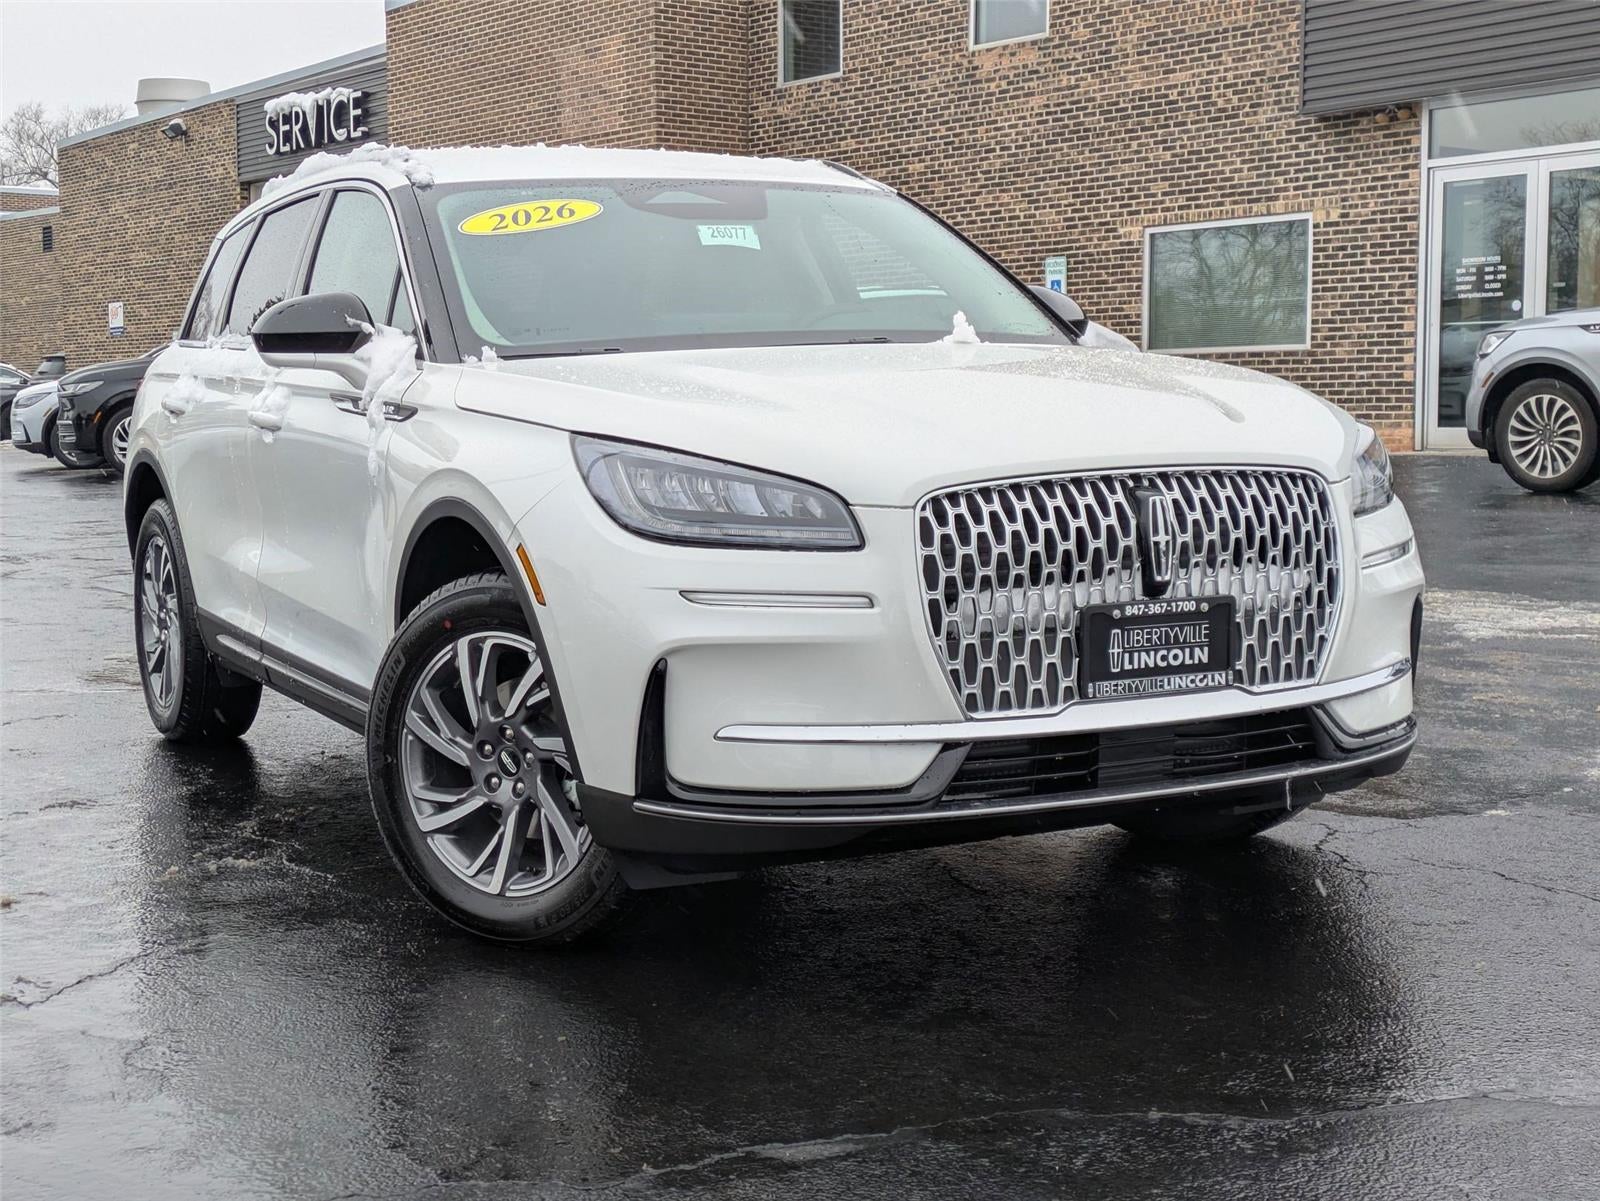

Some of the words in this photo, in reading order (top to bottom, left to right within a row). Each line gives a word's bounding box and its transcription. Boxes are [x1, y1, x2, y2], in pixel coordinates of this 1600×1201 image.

[265, 91, 362, 155] SERVICE
[488, 202, 576, 231] 2026
[707, 226, 746, 240] 26077
[1125, 601, 1196, 615] 847-367-1700
[1124, 624, 1210, 648] LIBERTYVILLE
[1123, 646, 1209, 670] LINCOLN
